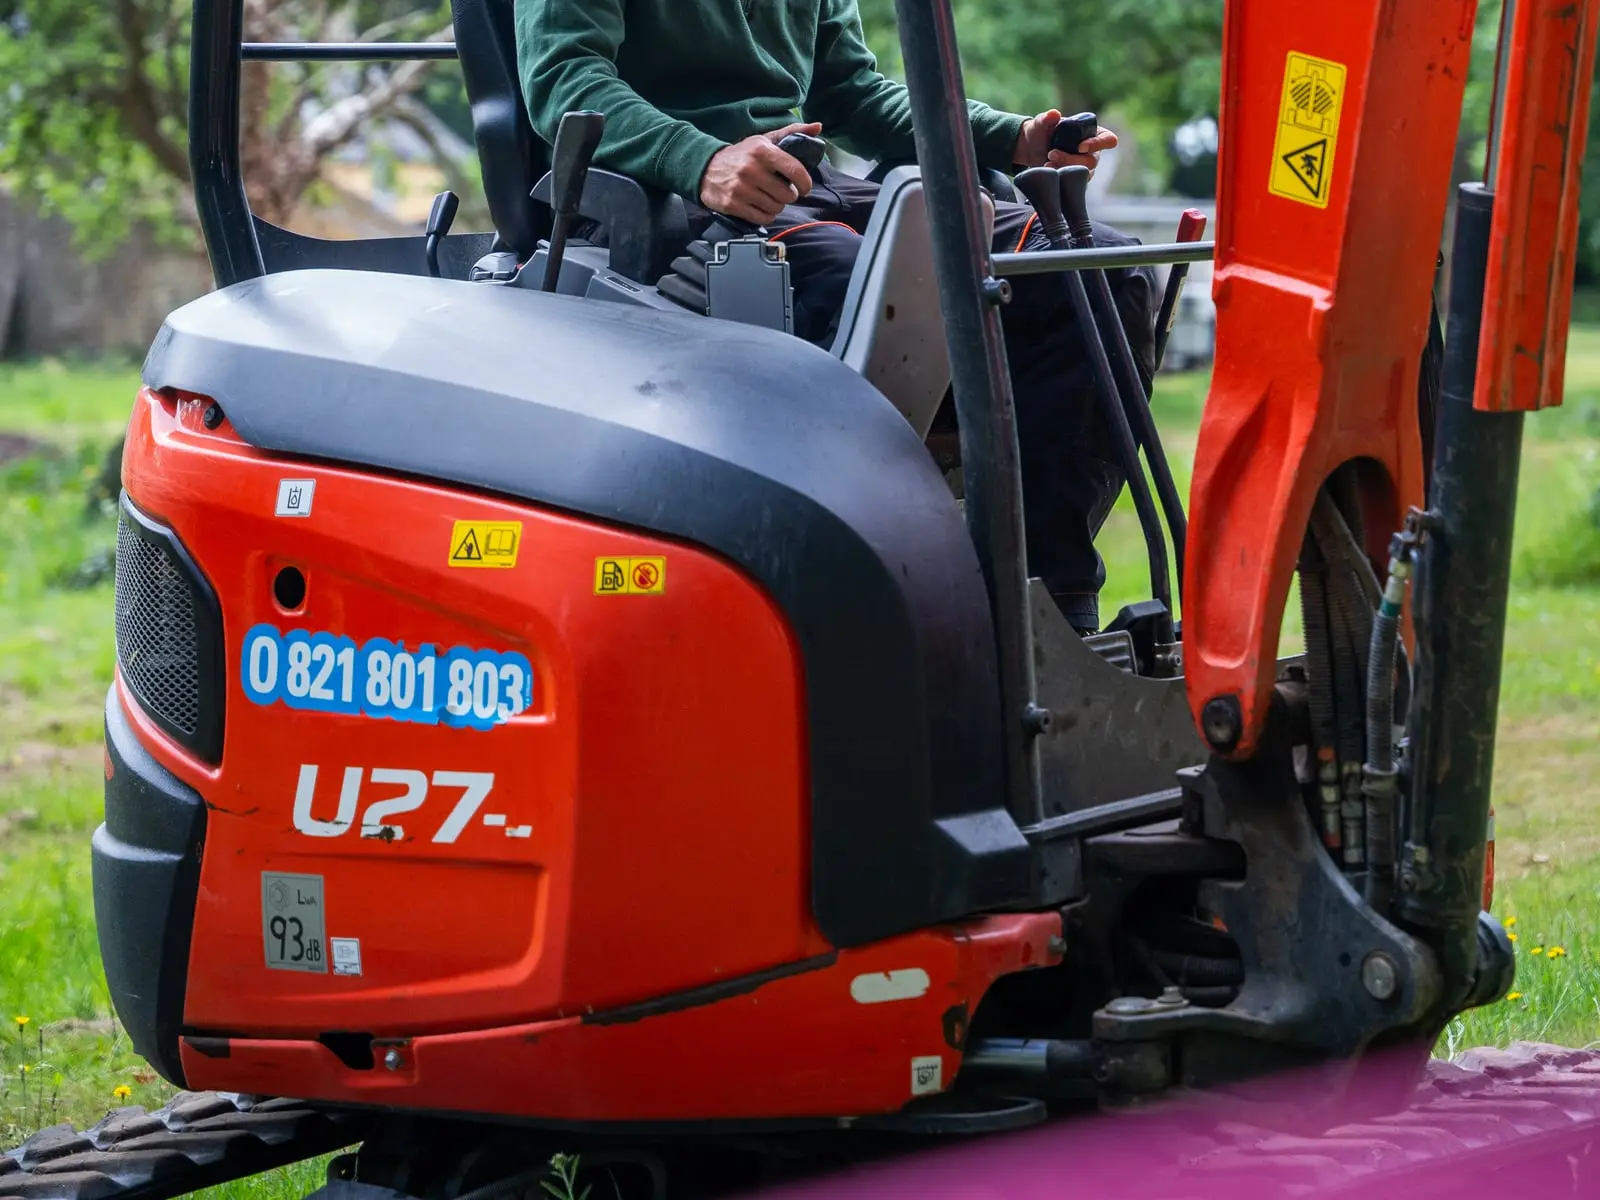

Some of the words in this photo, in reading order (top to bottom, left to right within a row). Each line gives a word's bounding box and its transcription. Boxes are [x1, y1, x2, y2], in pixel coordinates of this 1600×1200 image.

[250, 636, 279, 694] 0
[287, 641, 355, 703] 821
[366, 650, 436, 712] 801
[446, 659, 525, 720] 803
